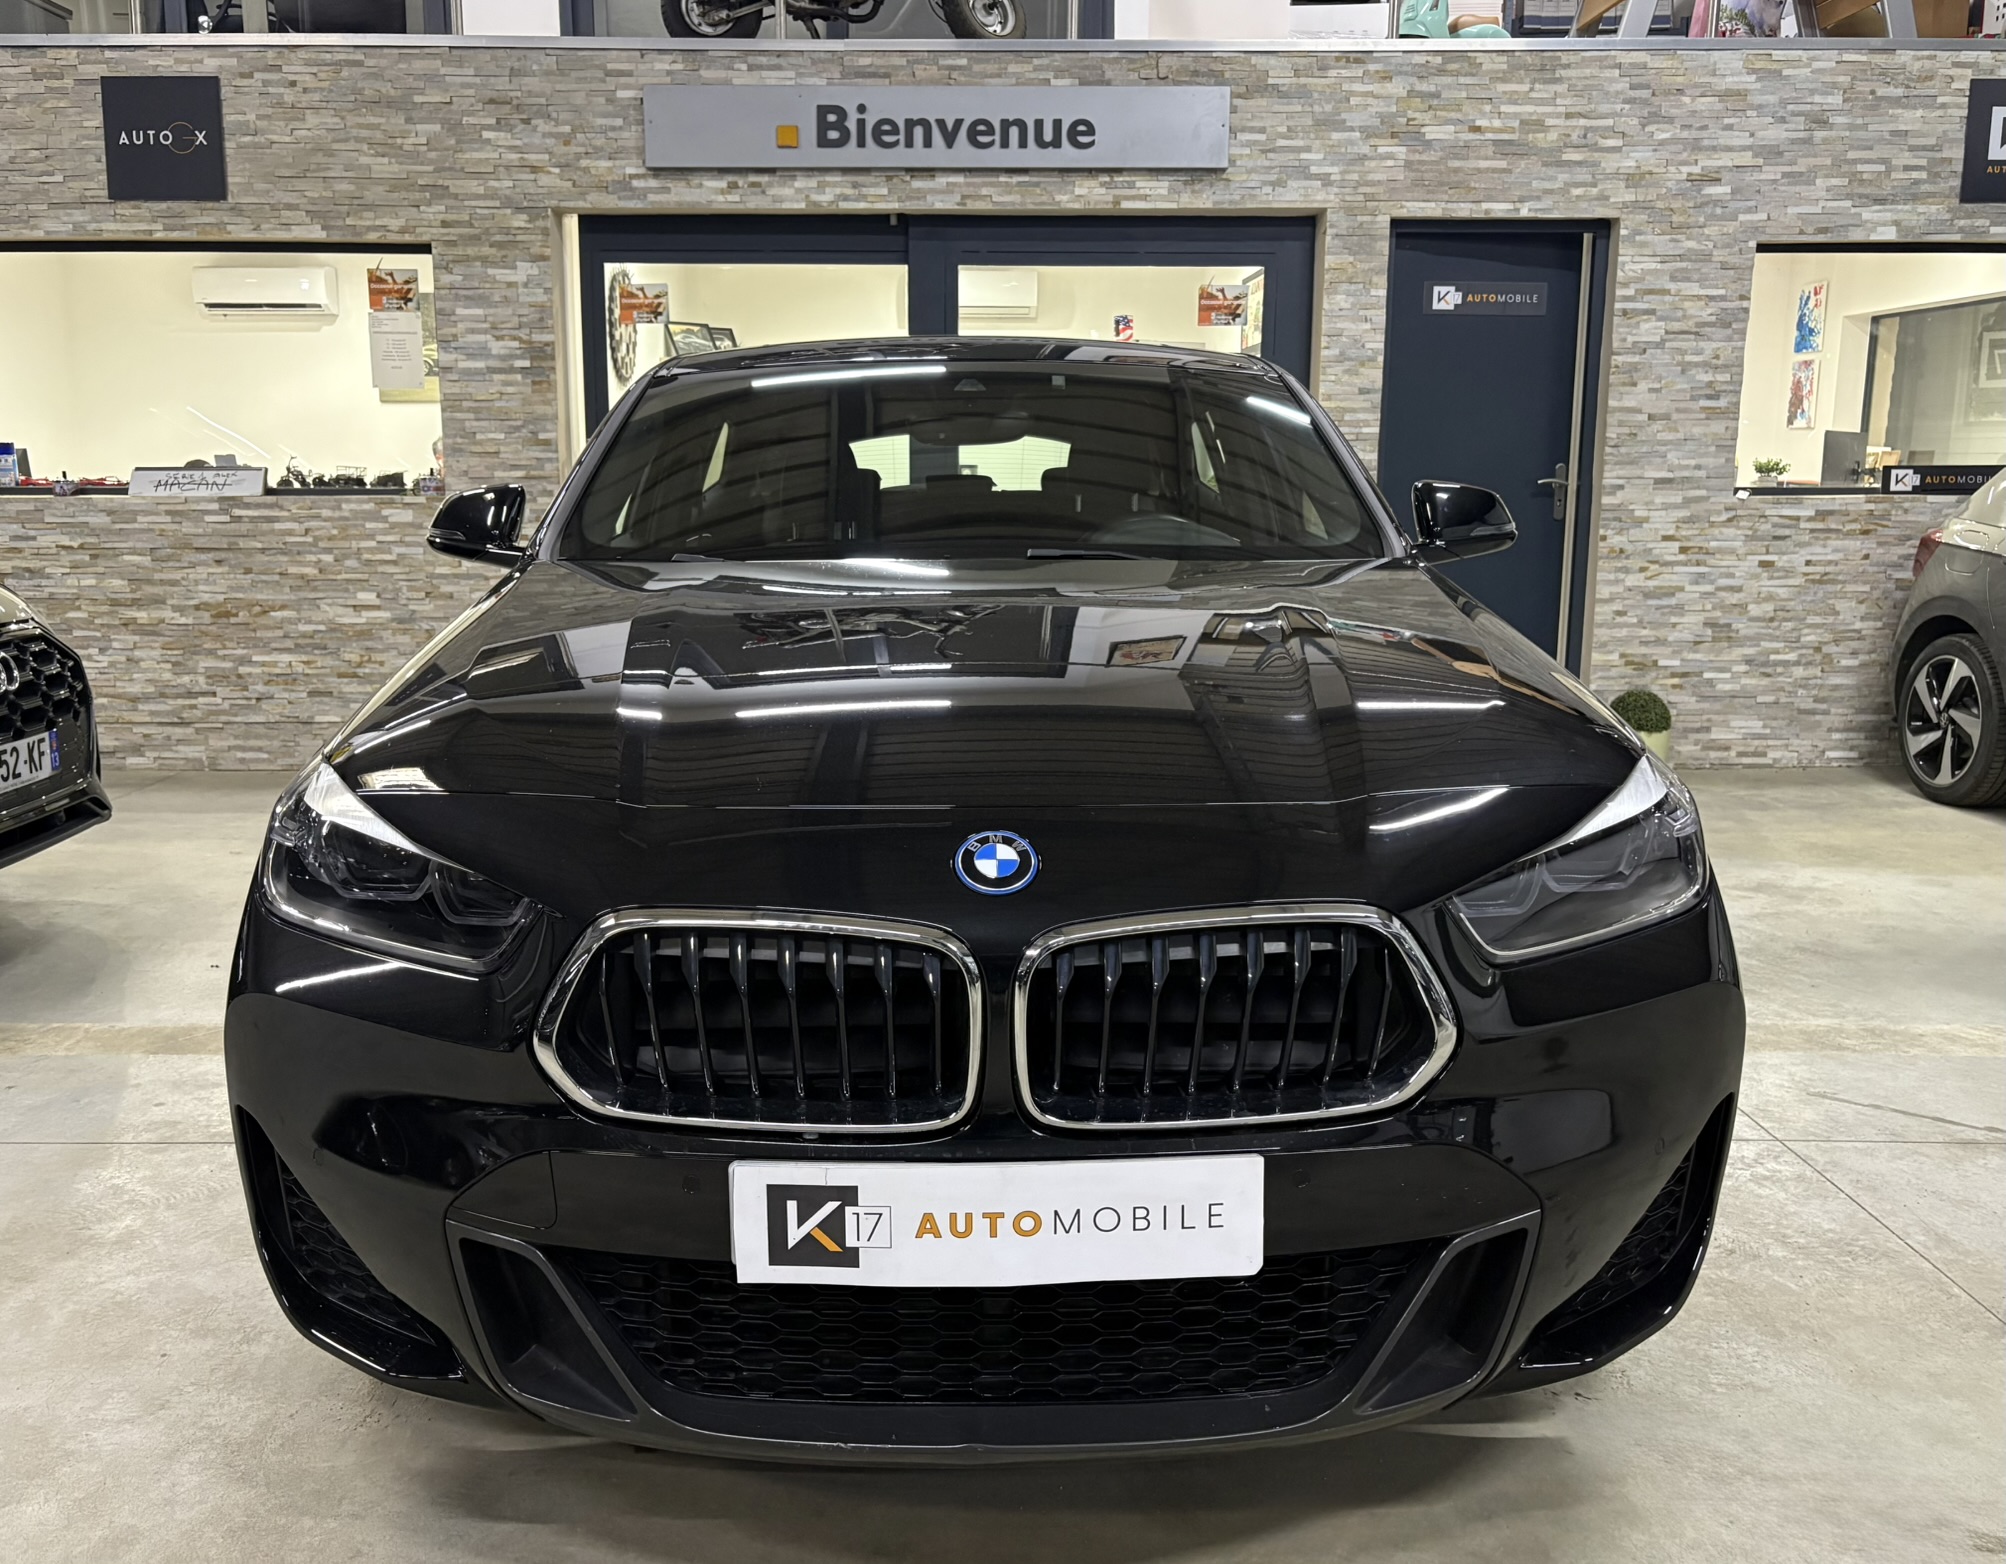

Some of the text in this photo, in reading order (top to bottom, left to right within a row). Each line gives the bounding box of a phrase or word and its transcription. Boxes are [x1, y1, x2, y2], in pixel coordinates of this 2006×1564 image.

[816, 103, 1097, 150] Bienvenue
[1466, 294, 1539, 303] AUTOMOBILE
[51, 751, 60, 768] 13
[967, 834, 1027, 852] BMW
[914, 1202, 1225, 1239] AUTOMOBILE
